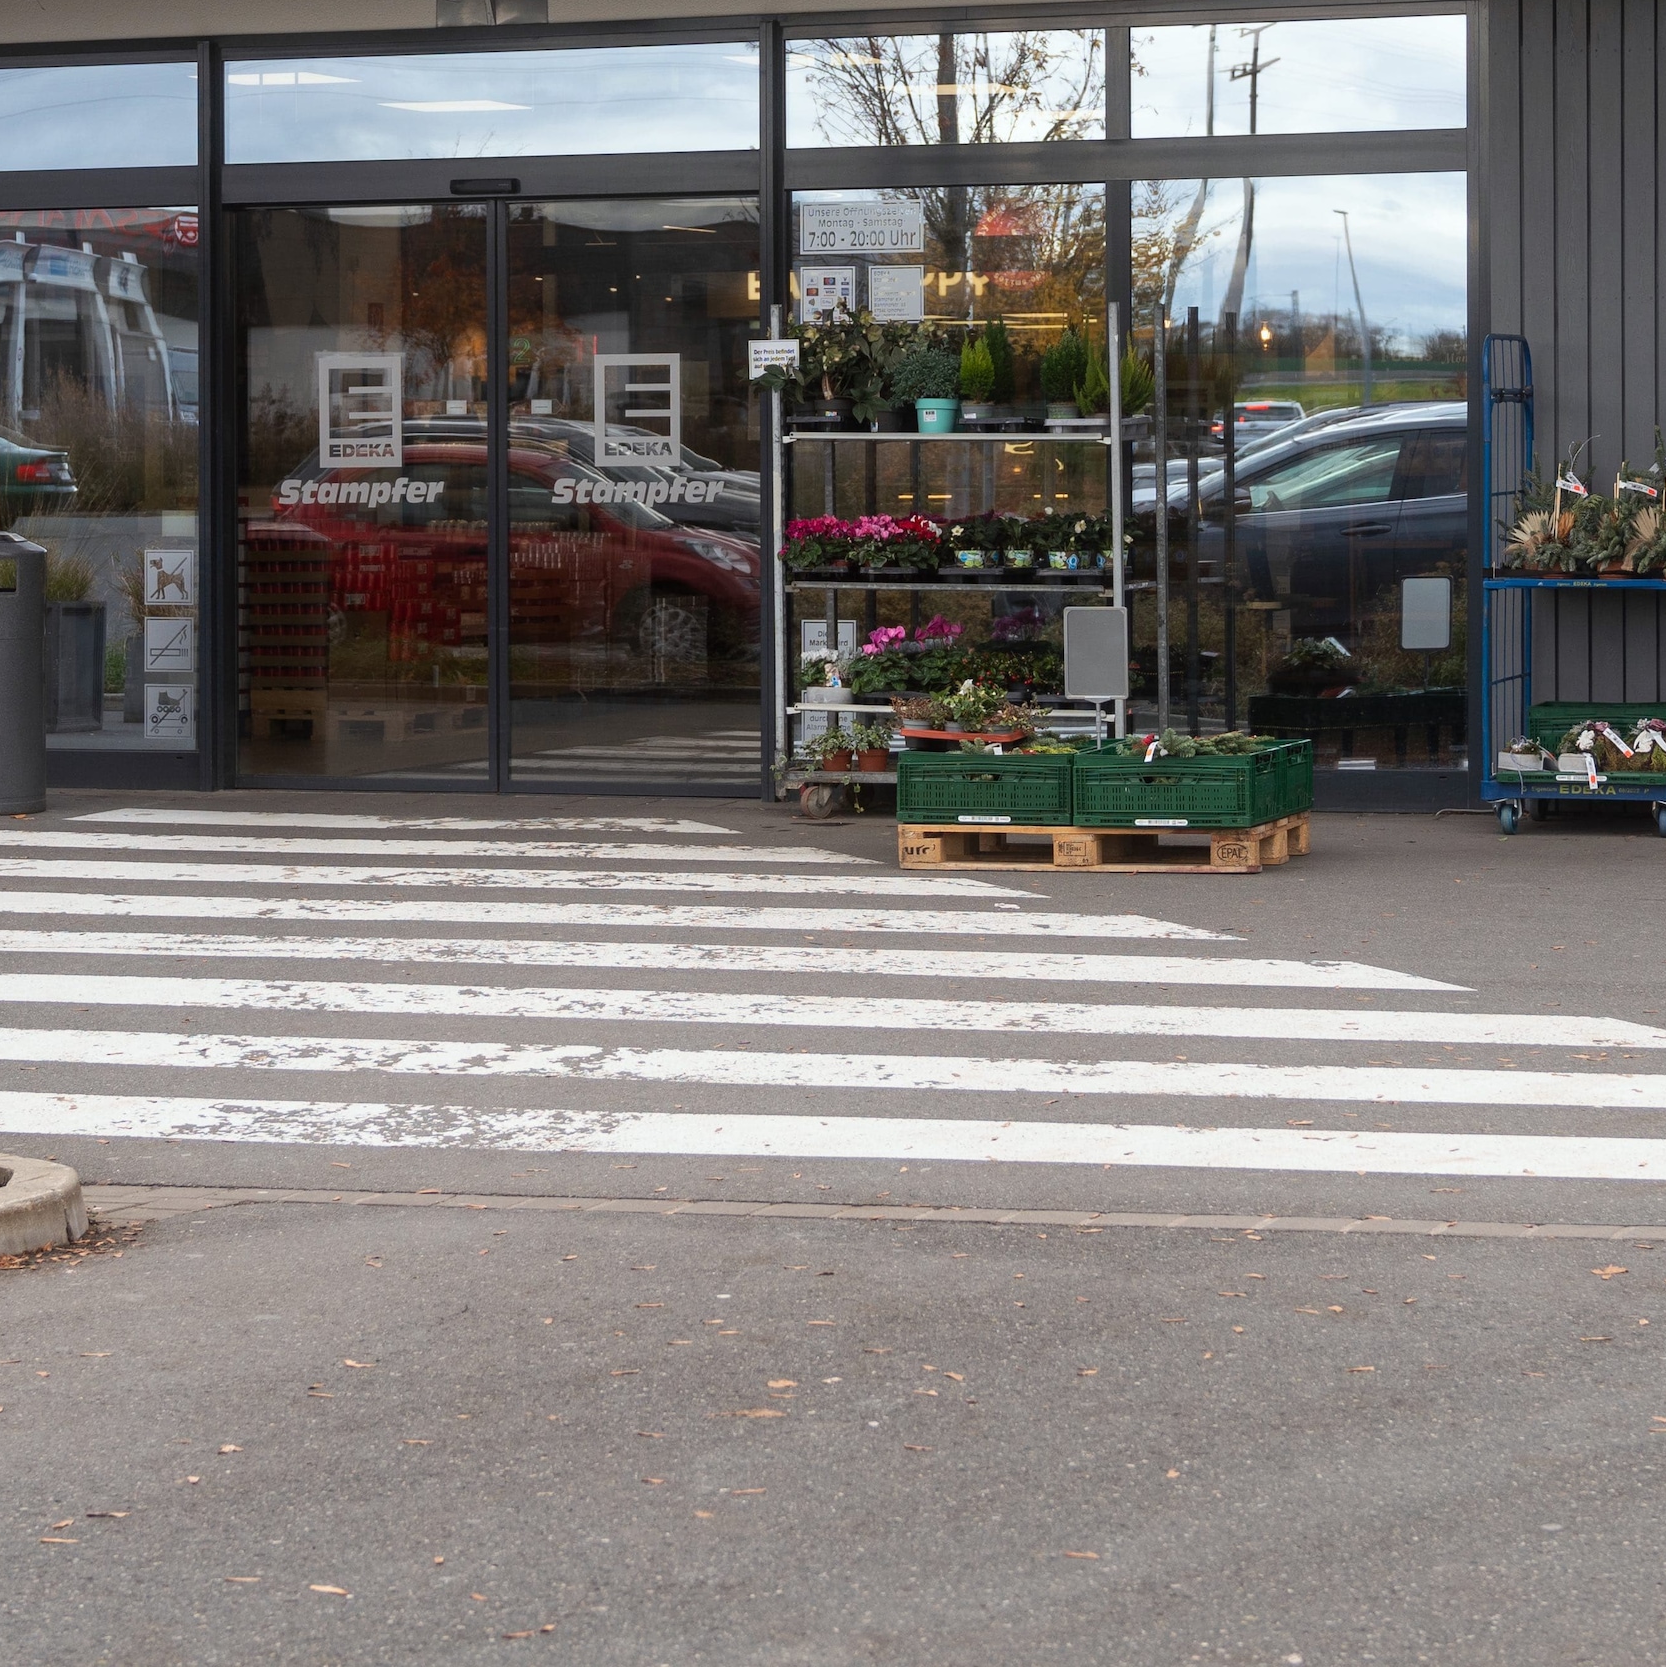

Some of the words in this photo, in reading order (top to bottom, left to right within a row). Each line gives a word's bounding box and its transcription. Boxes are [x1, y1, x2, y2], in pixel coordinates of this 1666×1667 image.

[808, 208, 840, 217] Unsere
[818, 219, 854, 228] Montag
[863, 218, 904, 227] Samstag
[808, 231, 836, 247] 7:00
[850, 230, 886, 247] 20:00
[890, 229, 916, 246] Uhr
[328, 443, 395, 459] EDEKA
[604, 441, 673, 457] EDEKA
[278, 477, 444, 509] Stampfer
[551, 476, 724, 509] Stampfer
[1559, 785, 1616, 795] EDEKA
[1221, 847, 1243, 858] EPAL
